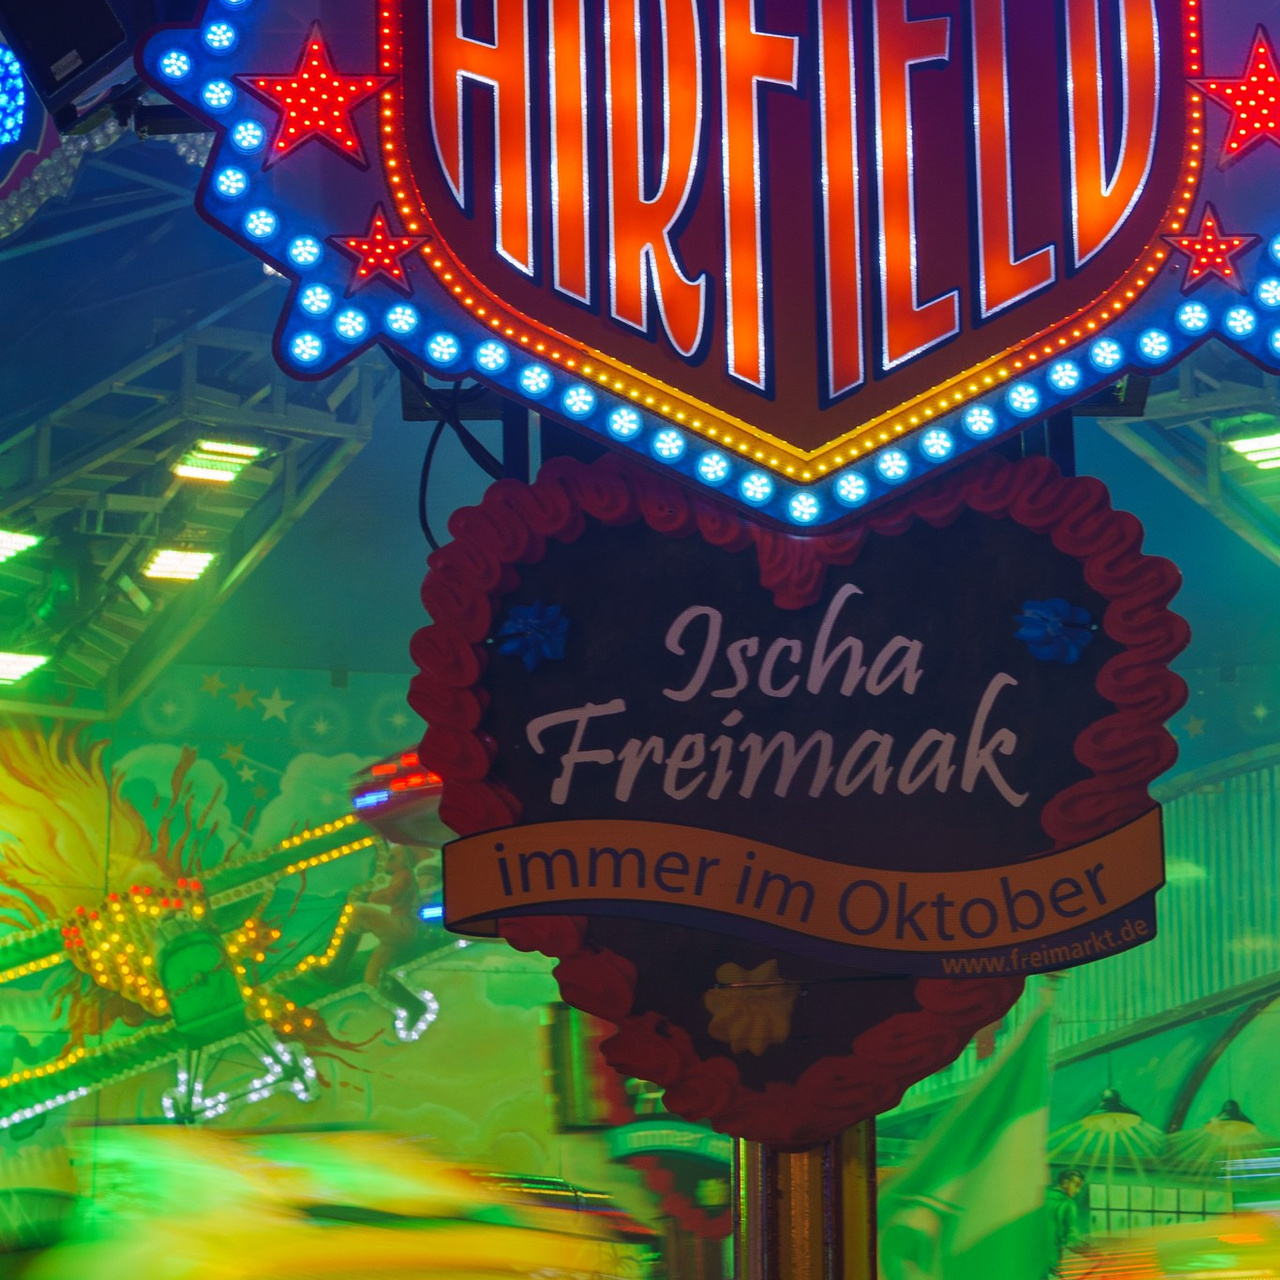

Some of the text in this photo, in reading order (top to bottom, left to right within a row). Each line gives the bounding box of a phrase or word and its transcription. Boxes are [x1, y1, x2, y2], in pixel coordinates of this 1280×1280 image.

[663, 583, 924, 701] Ischa
[527, 672, 1029, 807] Freimaak
[494, 842, 1109, 943] immer im Oktober
[942, 919, 1149, 975] www.freimarkt.de
